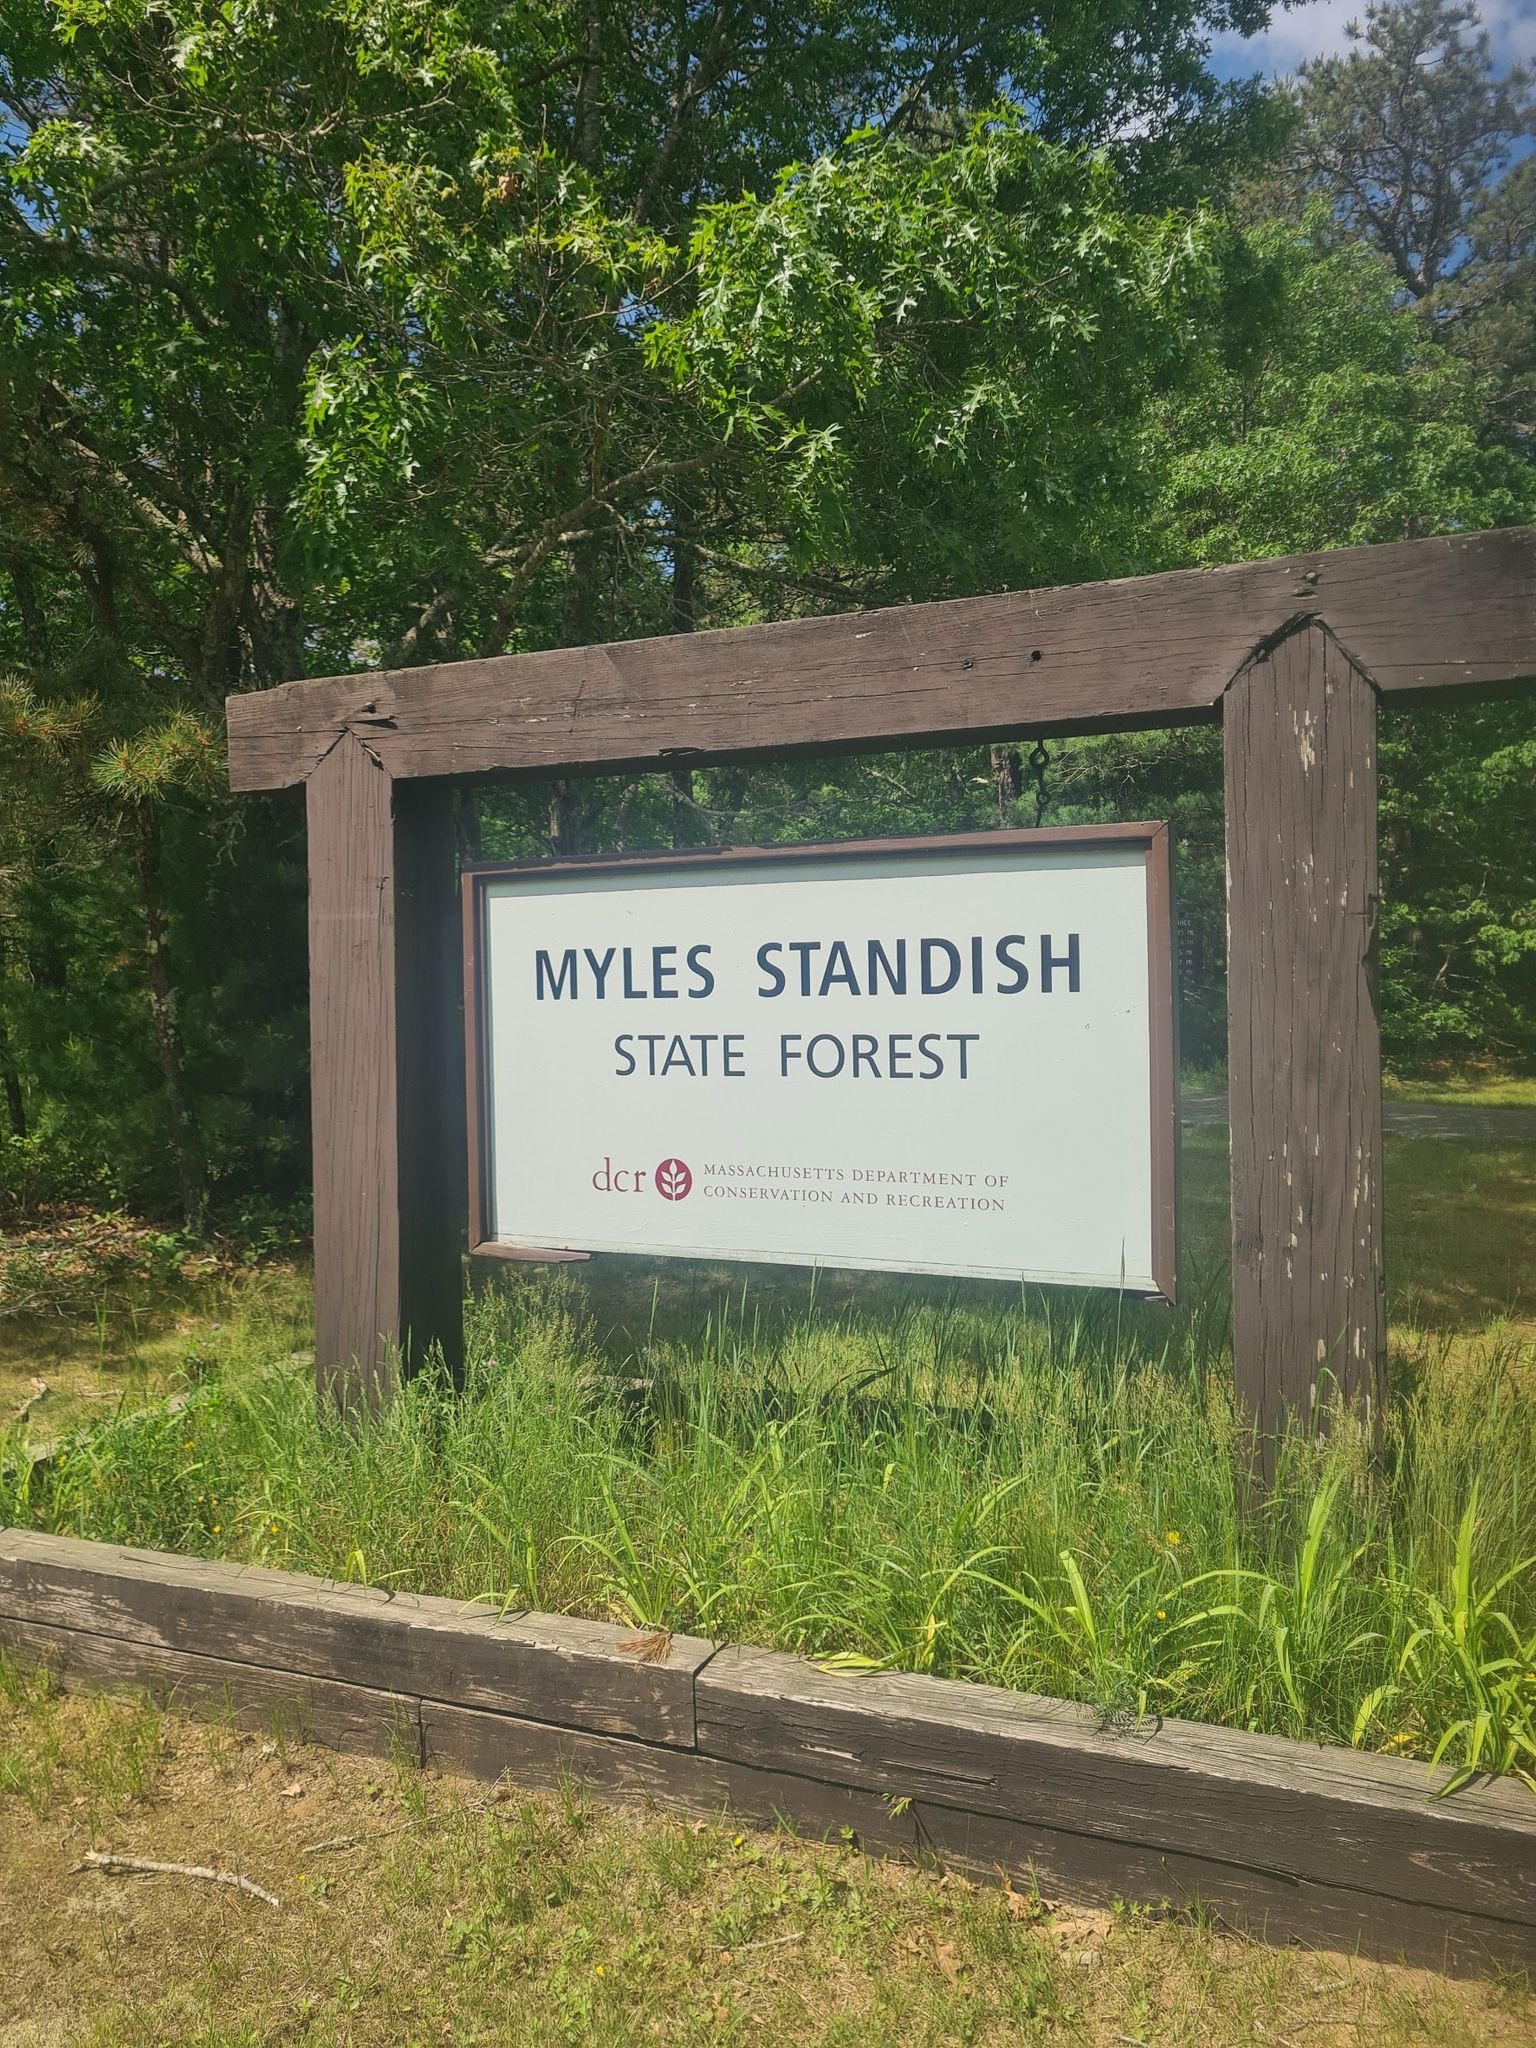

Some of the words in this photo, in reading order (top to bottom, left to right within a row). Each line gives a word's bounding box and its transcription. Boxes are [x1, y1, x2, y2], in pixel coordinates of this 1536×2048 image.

[536, 944, 714, 1000] MYLES
[757, 933, 1080, 998] STANDISH
[615, 1034, 745, 1076] STATE
[781, 1034, 979, 1079] FOREST
[593, 1157, 646, 1193] dcr
[704, 1164, 844, 1181] MASSACHUSETTS
[853, 1169, 977, 1187] DEPARTMENT
[985, 1175, 1009, 1188] OF
[704, 1186, 833, 1203] CONSERVATION
[841, 1192, 878, 1205] AND
[886, 1194, 1005, 1211] RECREATION
